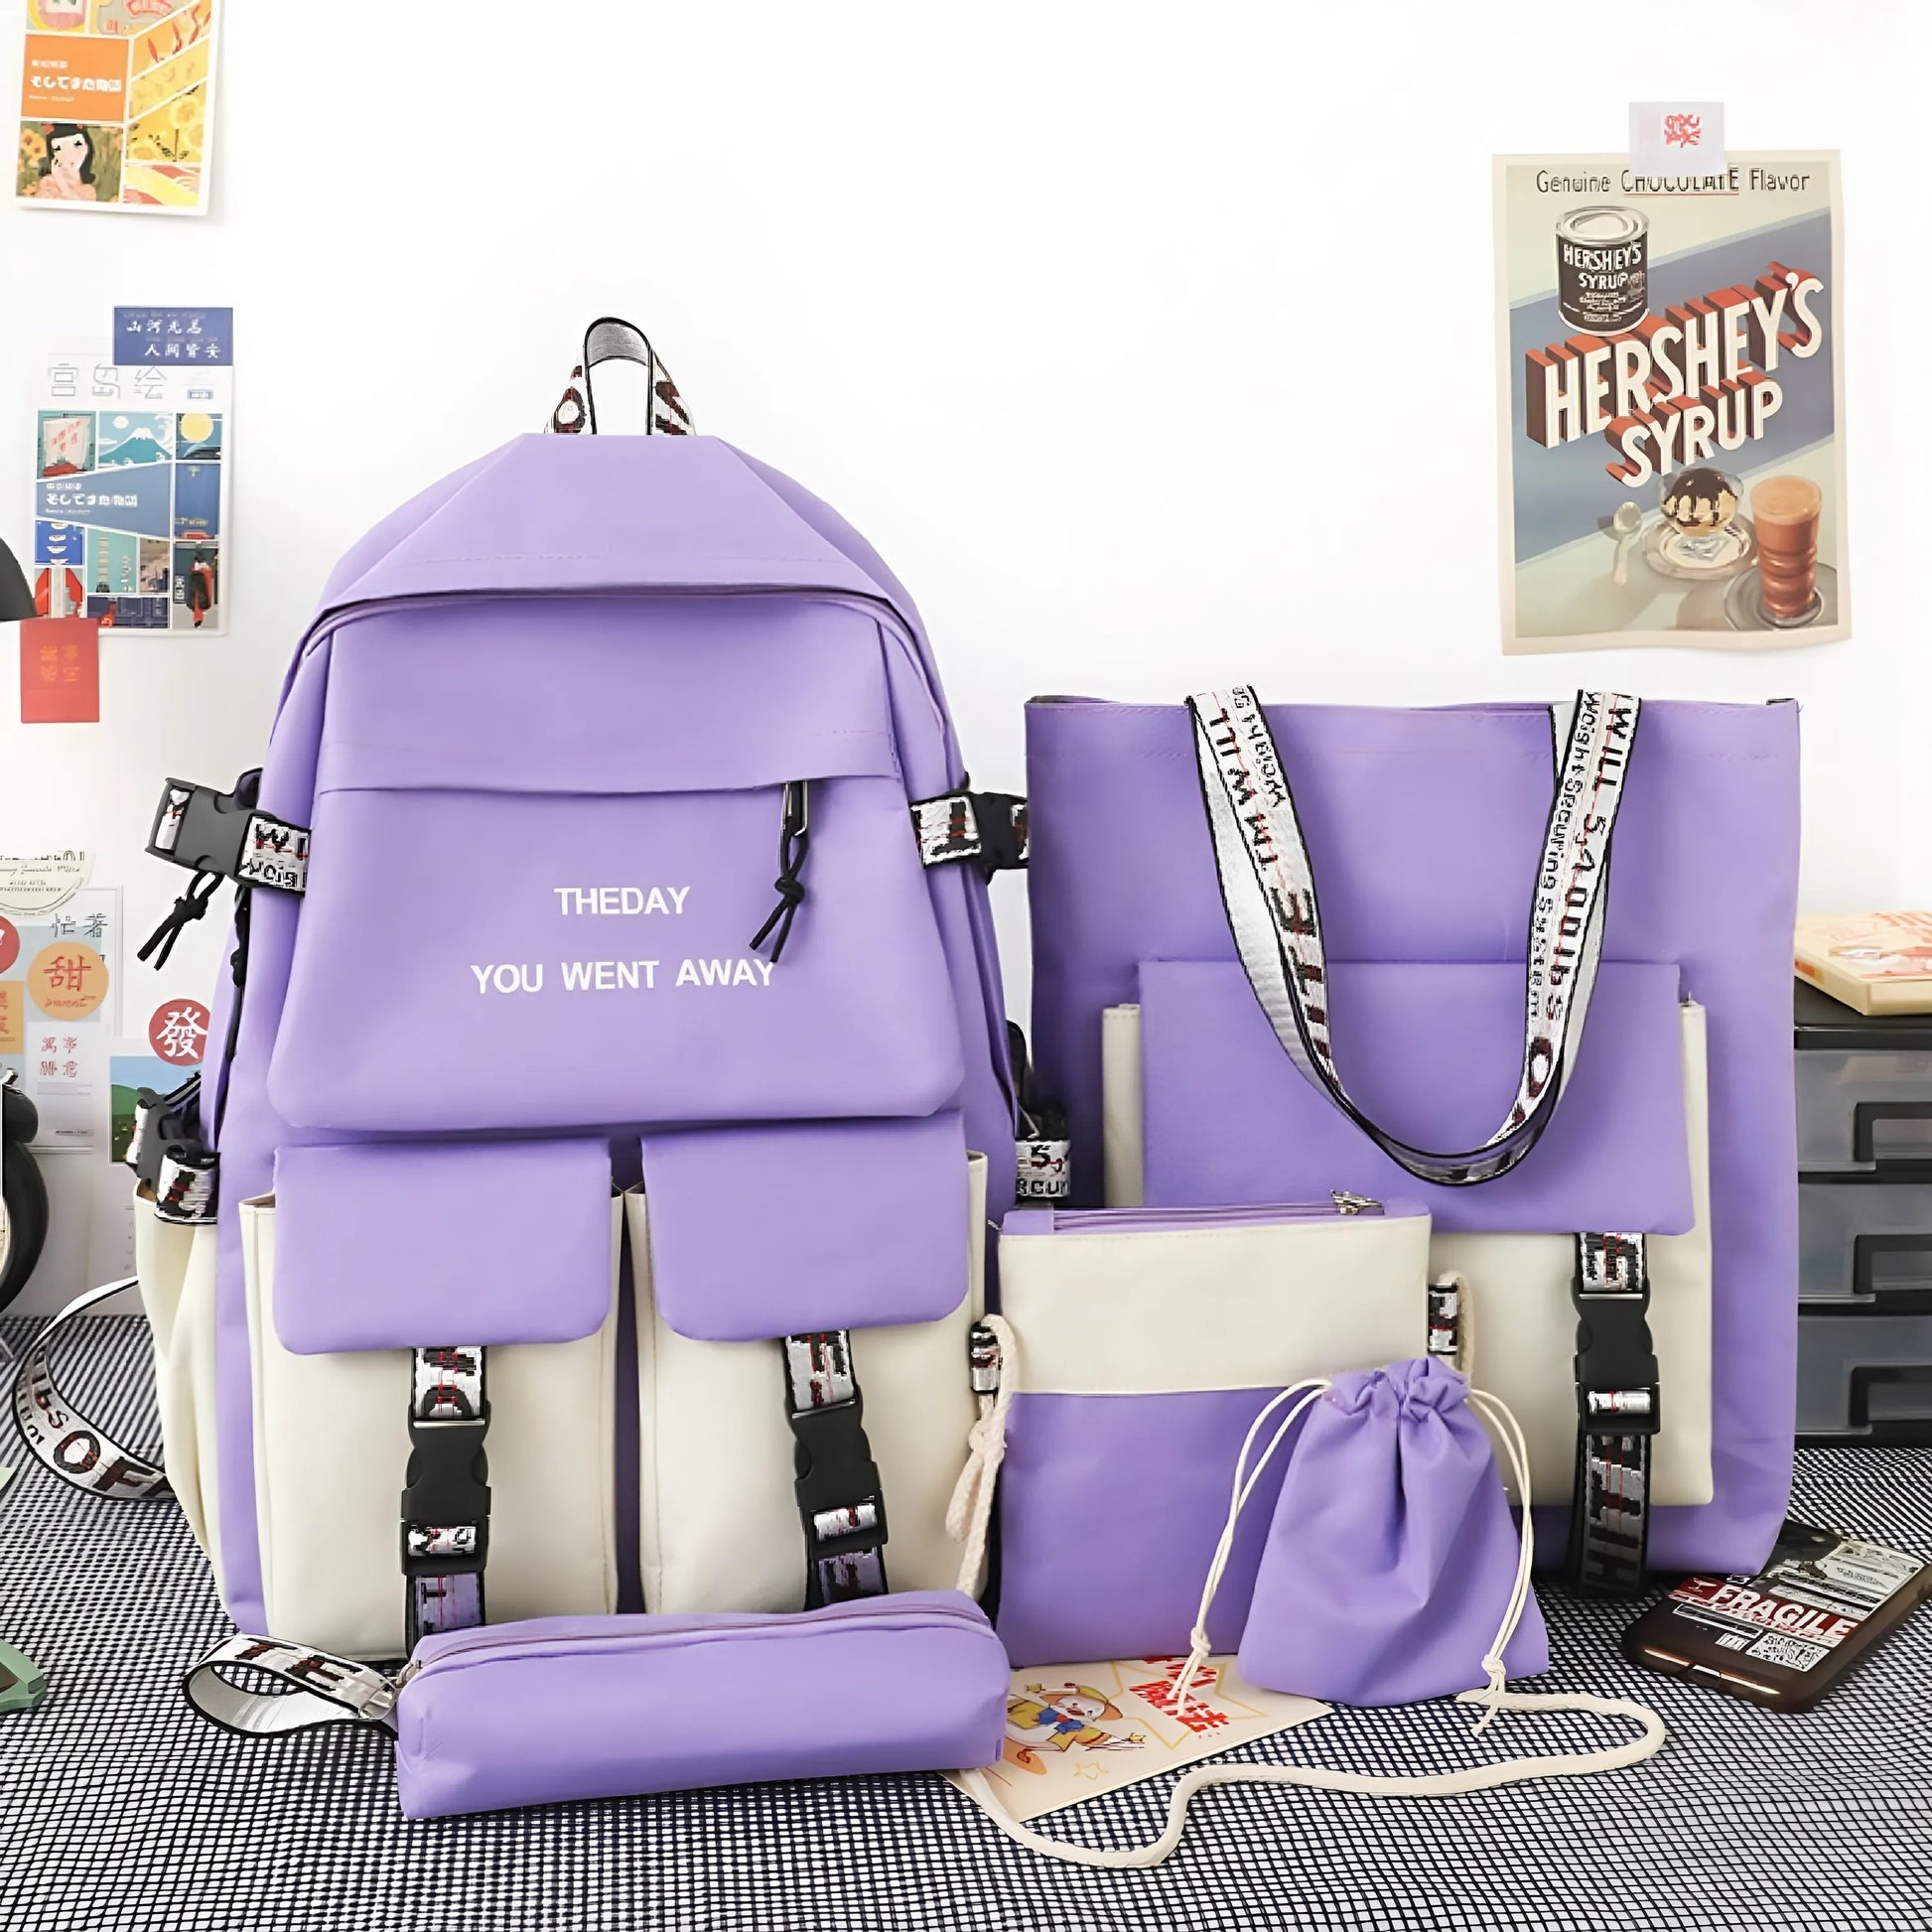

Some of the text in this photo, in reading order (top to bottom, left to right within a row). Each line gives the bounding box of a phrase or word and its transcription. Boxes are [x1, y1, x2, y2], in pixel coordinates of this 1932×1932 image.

[1536, 170, 1611, 193] Genuine
[1749, 168, 1810, 192] Flavor
[1614, 377, 1784, 487] SYRUP
[554, 886, 690, 915] THEDAY
[44, 954, 92, 992] 甜
[471, 958, 777, 993] YOU WENT AWAY
[156, 1006, 207, 1059] 發
[1708, 1586, 1860, 1639] FRAGILE
